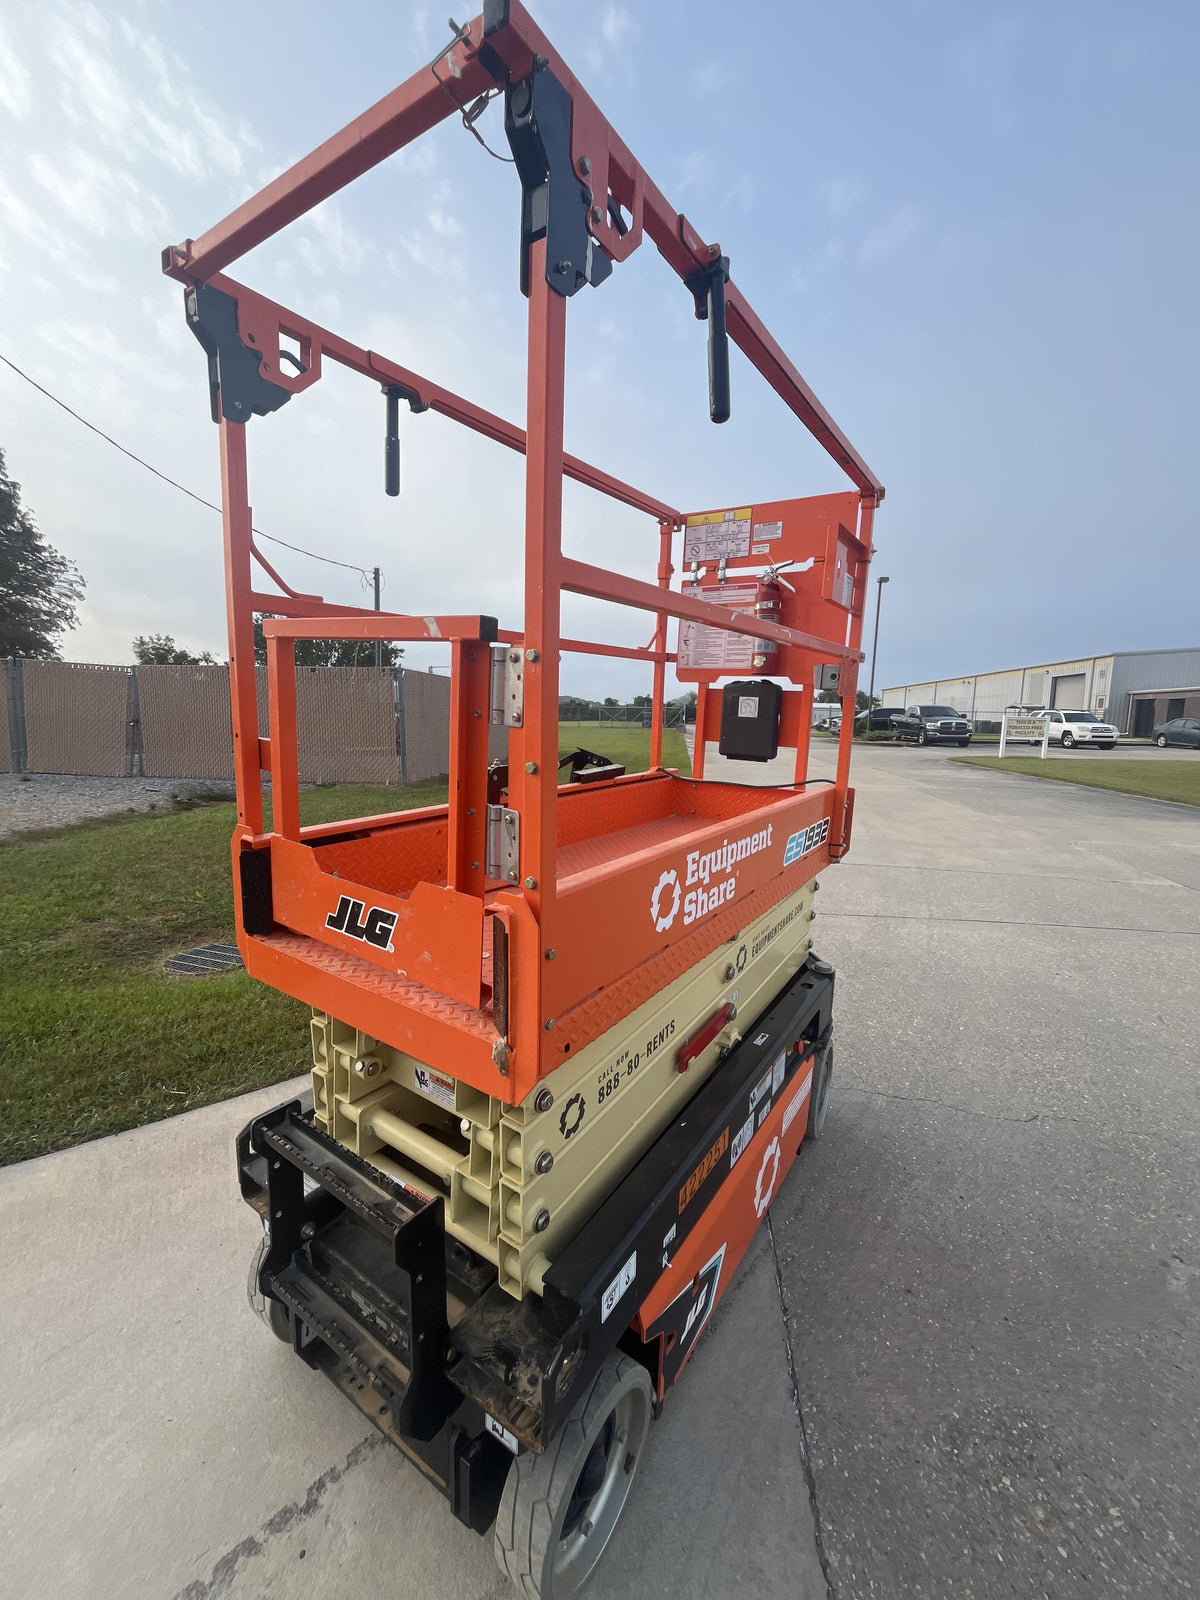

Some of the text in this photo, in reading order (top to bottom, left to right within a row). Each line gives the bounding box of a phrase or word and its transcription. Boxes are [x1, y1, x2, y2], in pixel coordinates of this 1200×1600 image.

[685, 823, 773, 886] Equipment
[784, 817, 830, 866] ES1932
[325, 894, 399, 952] JLG
[683, 877, 736, 926] Share
[752, 900, 804, 958] EQUIPMENTSHARE.COM
[597, 1050, 630, 1084] CALL NOW
[598, 1019, 676, 1104] 888-80-RENTS
